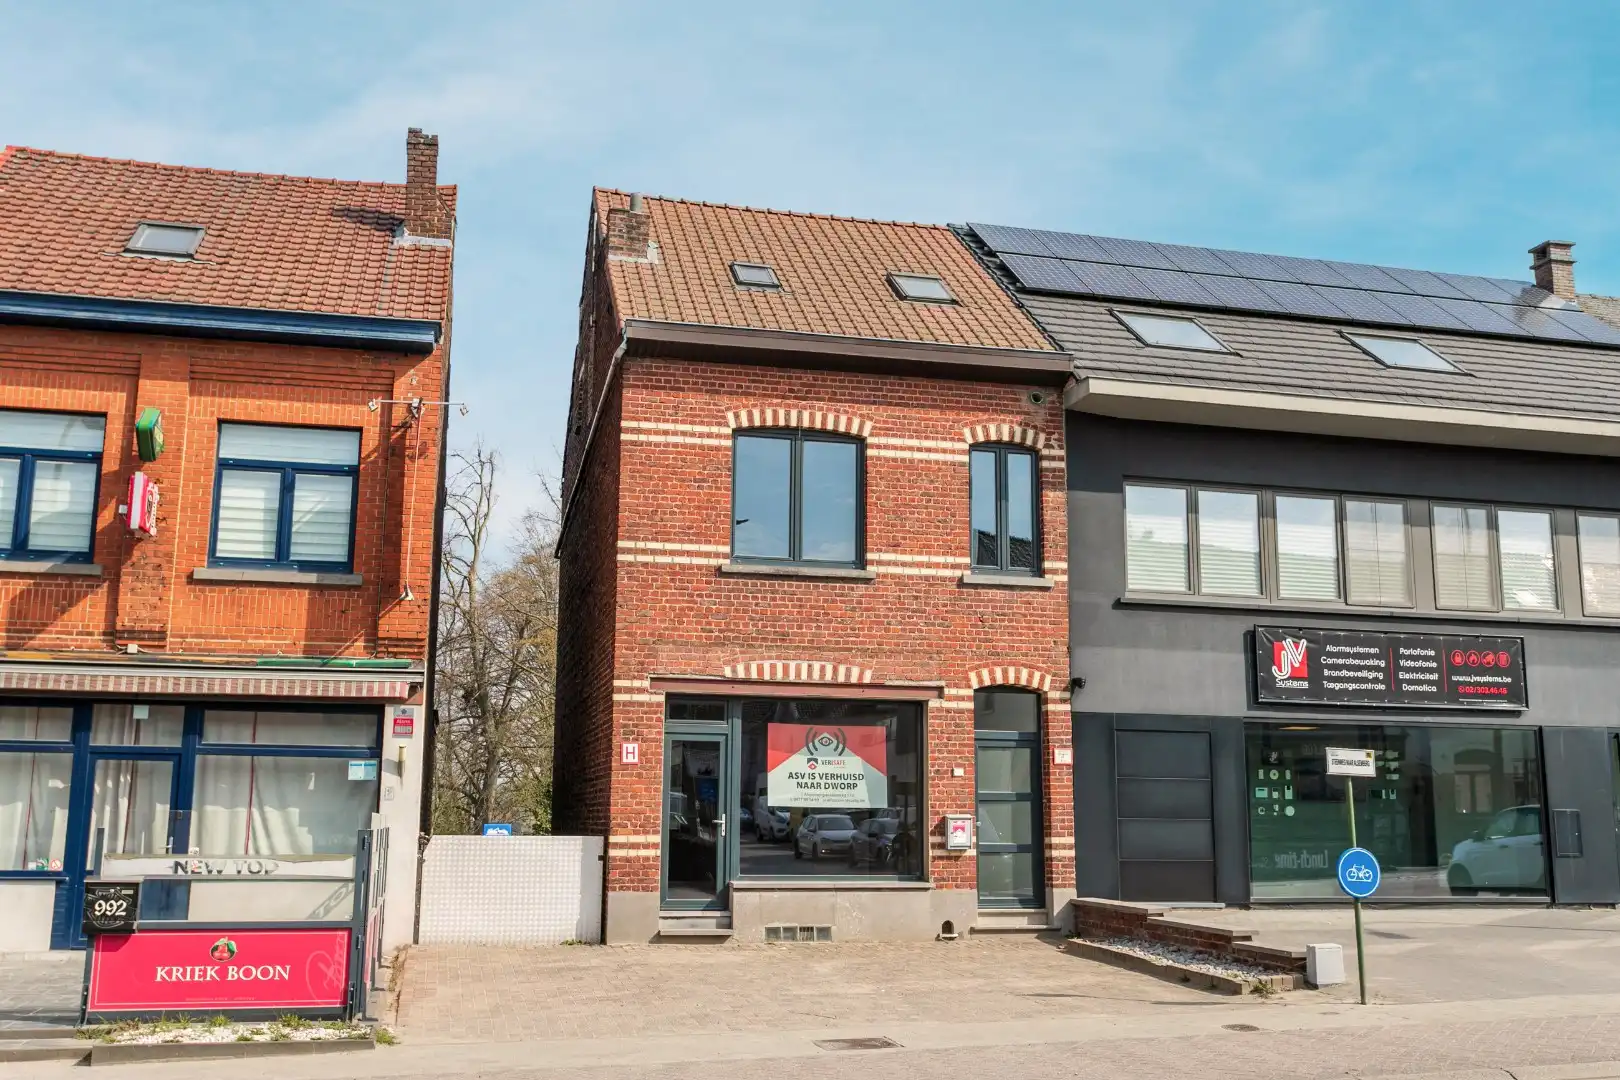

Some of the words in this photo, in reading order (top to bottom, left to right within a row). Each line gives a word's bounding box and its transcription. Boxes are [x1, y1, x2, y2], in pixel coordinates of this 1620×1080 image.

[1325, 644, 1380, 655] Alarmsystemen
[1399, 647, 1436, 657] Parlofonie
[1320, 656, 1386, 668] Camerabewaking
[1398, 659, 1438, 669] Videofonie
[1323, 668, 1384, 680] Brandbeveiliging
[1398, 671, 1439, 681] Elektriciteit
[1451, 674, 1512, 684] www.jvsystems.be
[1275, 678, 1309, 688] Systems
[1322, 680, 1386, 691] Toegangscontrole
[1402, 683, 1437, 693] Domotica
[625, 746, 636, 760] H
[787, 771, 806, 780] ASV
[807, 772, 816, 780] IS
[818, 772, 865, 781] VERHUISD
[796, 781, 821, 790] NAAR
[823, 782, 858, 790] DWORP
[94, 899, 127, 917] 992
[154, 965, 221, 983] KRIEK
[226, 964, 292, 982] BOON
